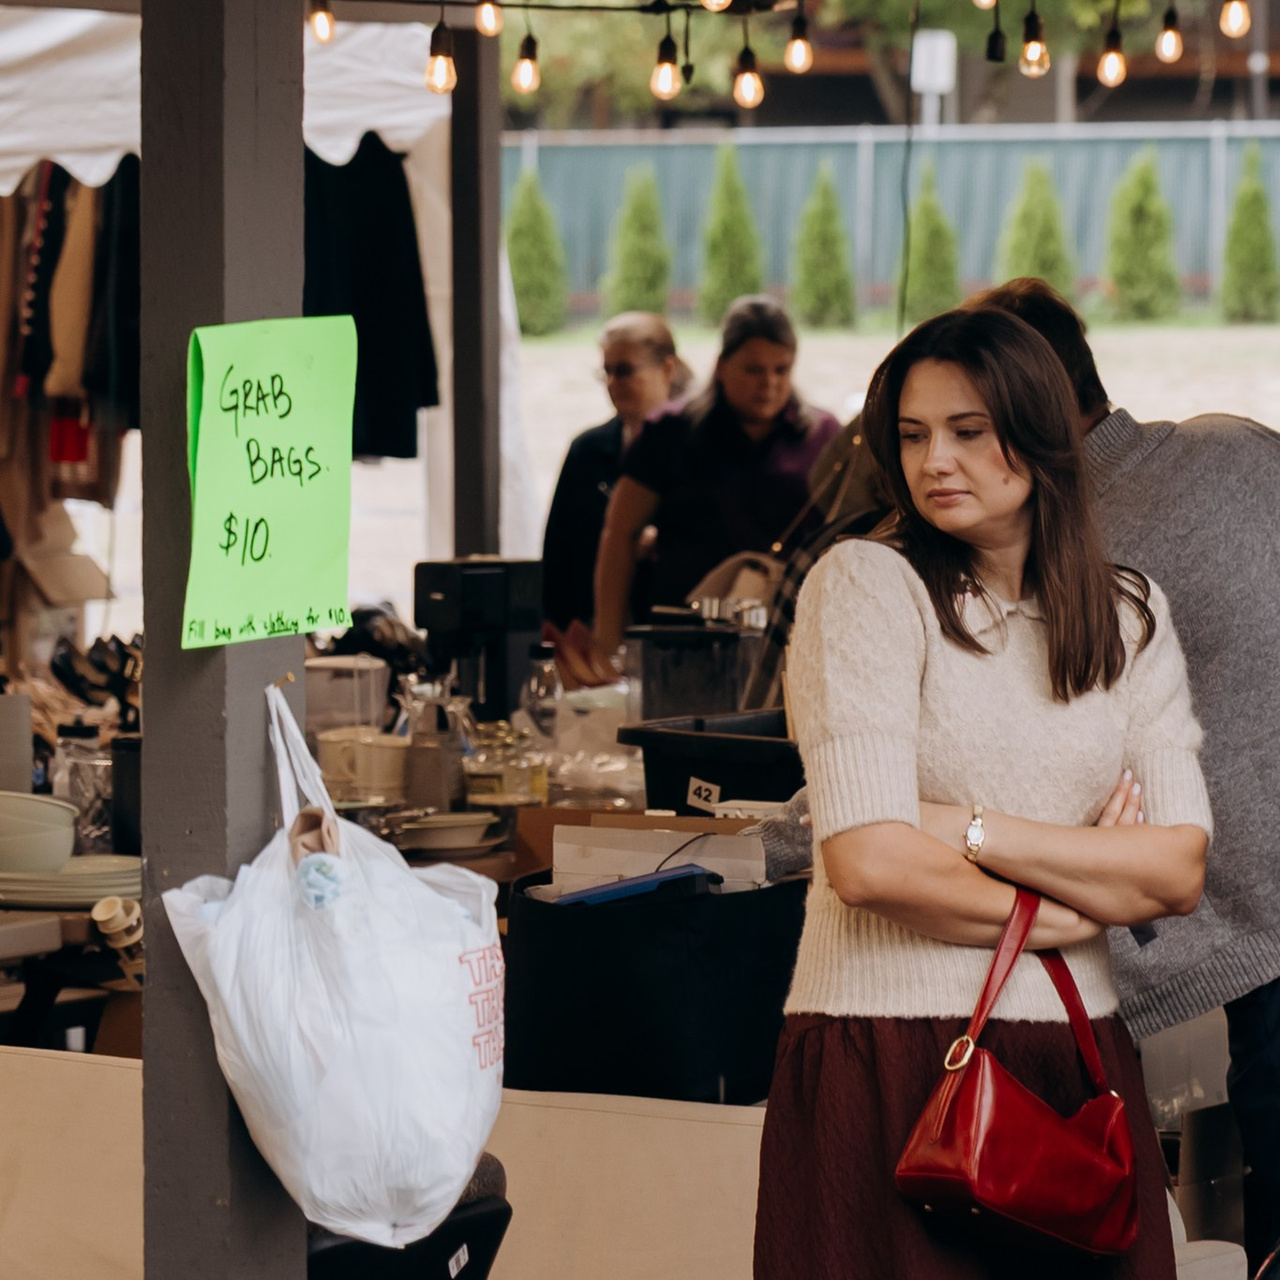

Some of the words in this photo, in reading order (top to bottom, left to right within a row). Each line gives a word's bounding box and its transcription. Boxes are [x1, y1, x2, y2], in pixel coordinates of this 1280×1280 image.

[219, 364, 292, 437] GRAB
[214, 620, 232, 640] bag
[693, 785, 712, 803] 42
